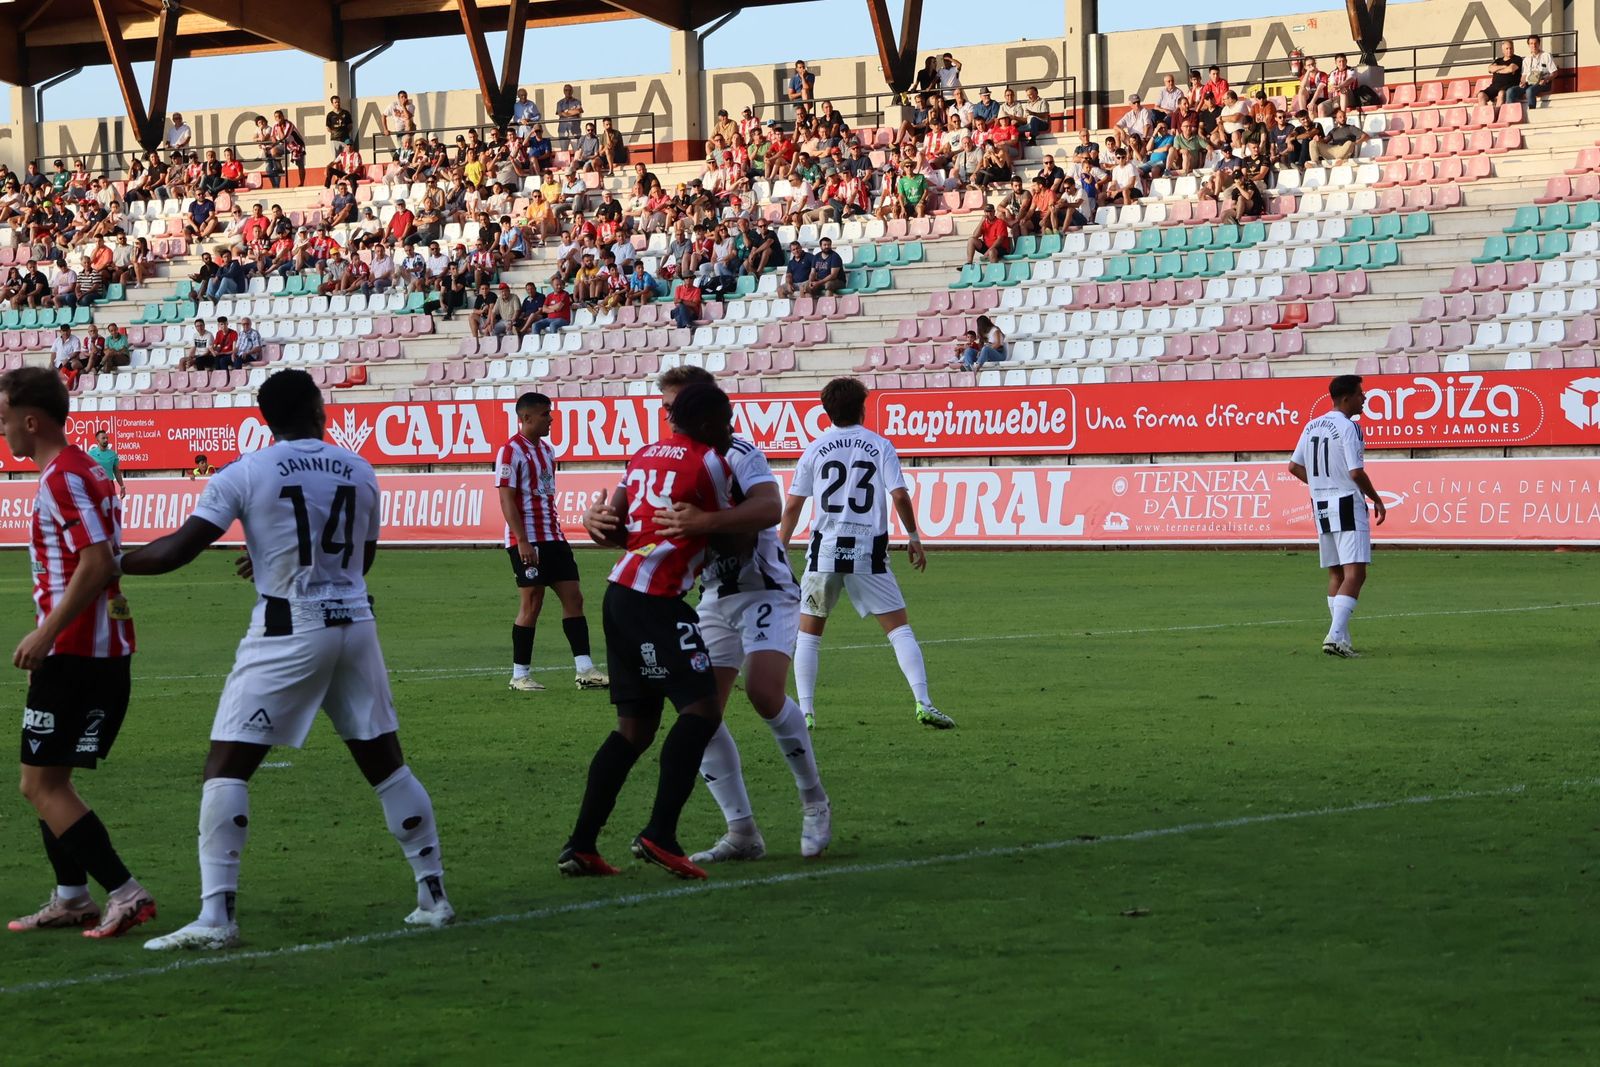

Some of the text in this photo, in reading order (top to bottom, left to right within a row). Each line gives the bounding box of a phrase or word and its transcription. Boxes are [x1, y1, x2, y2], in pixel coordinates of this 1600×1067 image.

[65, 416, 114, 434] Dental
[884, 401, 1066, 442] Rapimueble
[1085, 401, 1299, 430] Una forma diferente
[117, 430, 135, 440] Sangre
[167, 424, 236, 440] CARPINTERÍA
[375, 403, 492, 459] CAJA
[1431, 425, 1437, 434] Y
[1443, 423, 1520, 435] JAMONES
[117, 442, 140, 450] ZAMORA
[189, 439, 236, 452] HIJOS DE
[819, 439, 880, 458] MANU RICO
[1310, 436, 1330, 477] 11
[277, 458, 353, 481] JANNICK
[821, 460, 876, 514] 23
[1134, 470, 1271, 493] TERNERA
[1413, 478, 1502, 494] CLÍNICA
[625, 469, 676, 532] 24
[1410, 497, 1468, 524] JOSÉ
[1480, 503, 1510, 523] DE
[278, 485, 356, 569] 14
[1135, 522, 1271, 532] www.terneradealiste.es
[756, 603, 772, 629] 2
